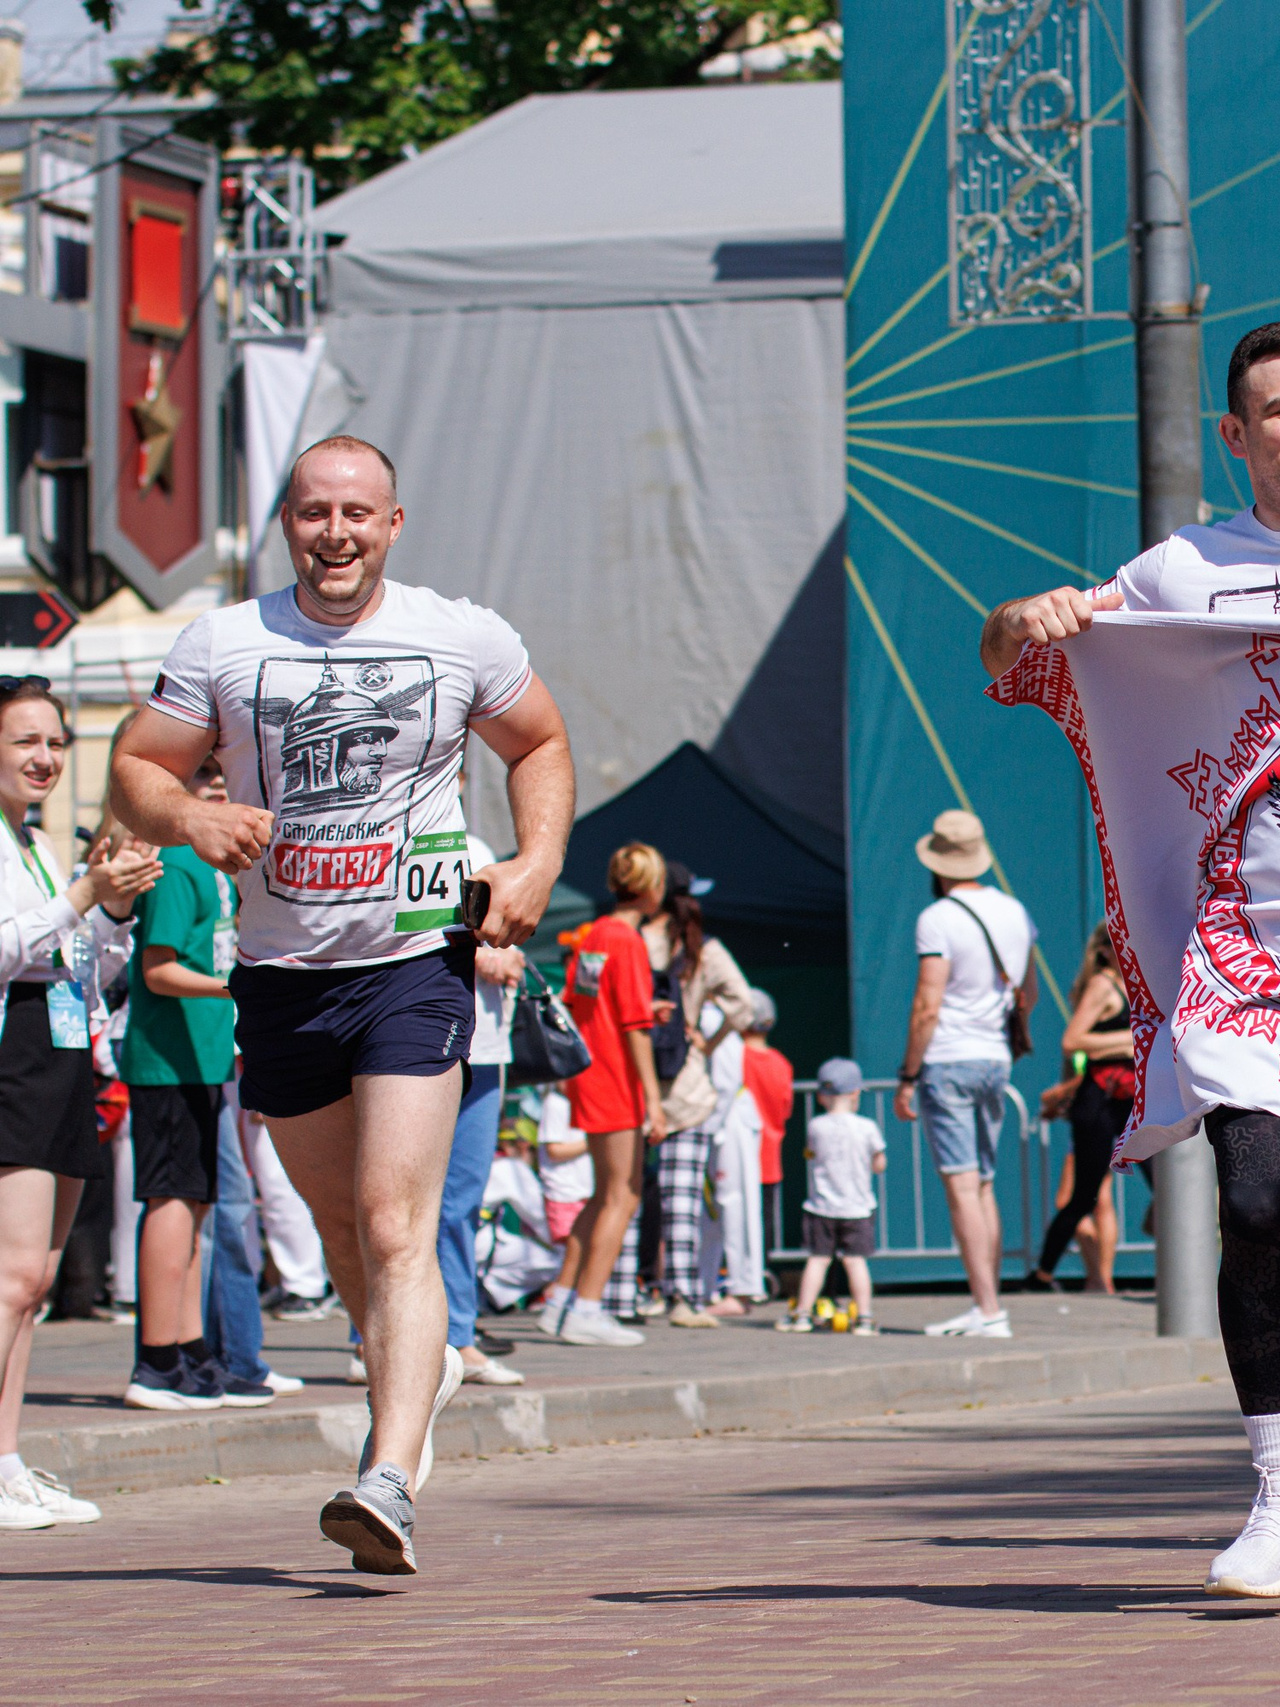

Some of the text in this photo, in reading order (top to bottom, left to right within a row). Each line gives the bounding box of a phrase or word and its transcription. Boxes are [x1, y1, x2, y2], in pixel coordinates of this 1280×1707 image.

[283, 821, 384, 841] СМОЛЕНСКИЕ
[281, 849, 383, 885] ВИТЯЗИ
[407, 859, 472, 903] 041
